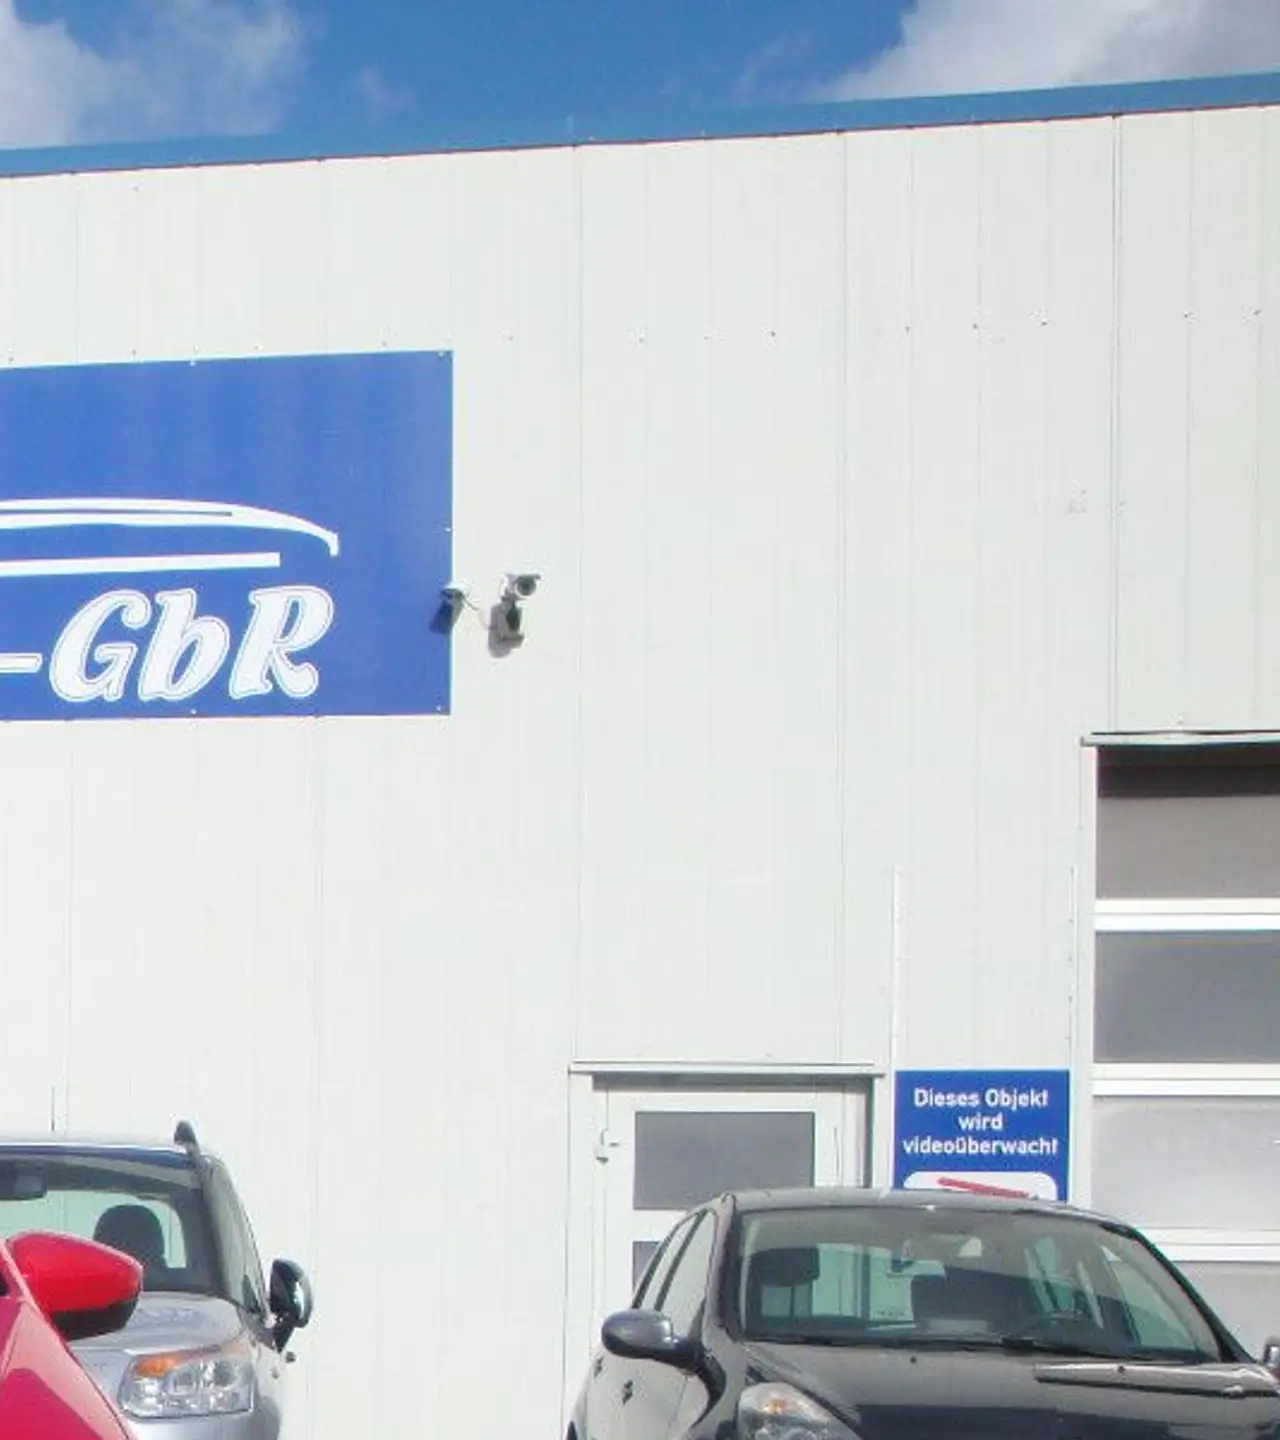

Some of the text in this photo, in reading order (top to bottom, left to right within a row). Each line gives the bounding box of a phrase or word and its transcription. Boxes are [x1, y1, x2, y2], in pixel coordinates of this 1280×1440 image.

[914, 1087, 1049, 1111] Dieses Objekt
[958, 1111, 1004, 1131] wird
[903, 1135, 1059, 1155] videoüberwacht
